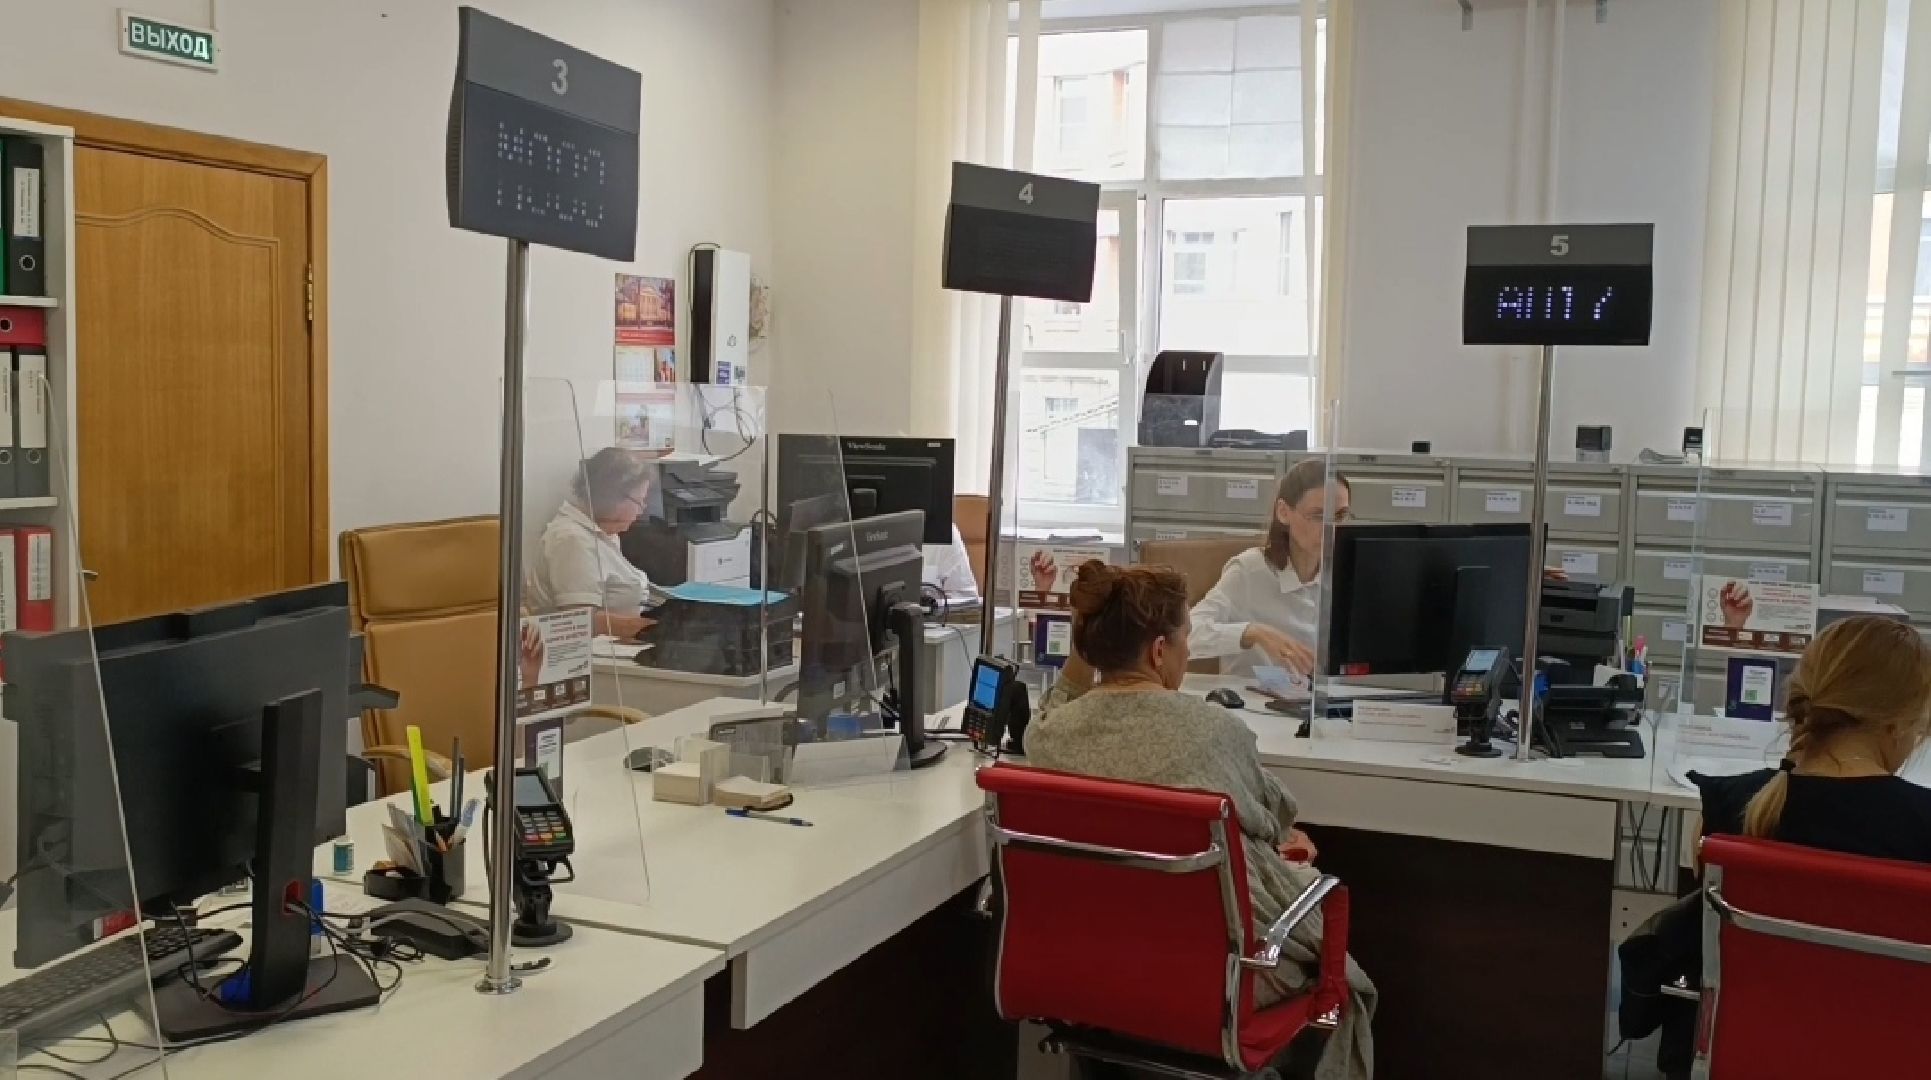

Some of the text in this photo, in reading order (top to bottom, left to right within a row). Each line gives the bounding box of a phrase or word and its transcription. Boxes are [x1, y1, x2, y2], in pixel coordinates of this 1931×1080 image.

[131, 22, 210, 60] ВЫХОД
[551, 58, 569, 95] 3
[1018, 181, 1034, 205] 4
[1550, 235, 1569, 256] 5
